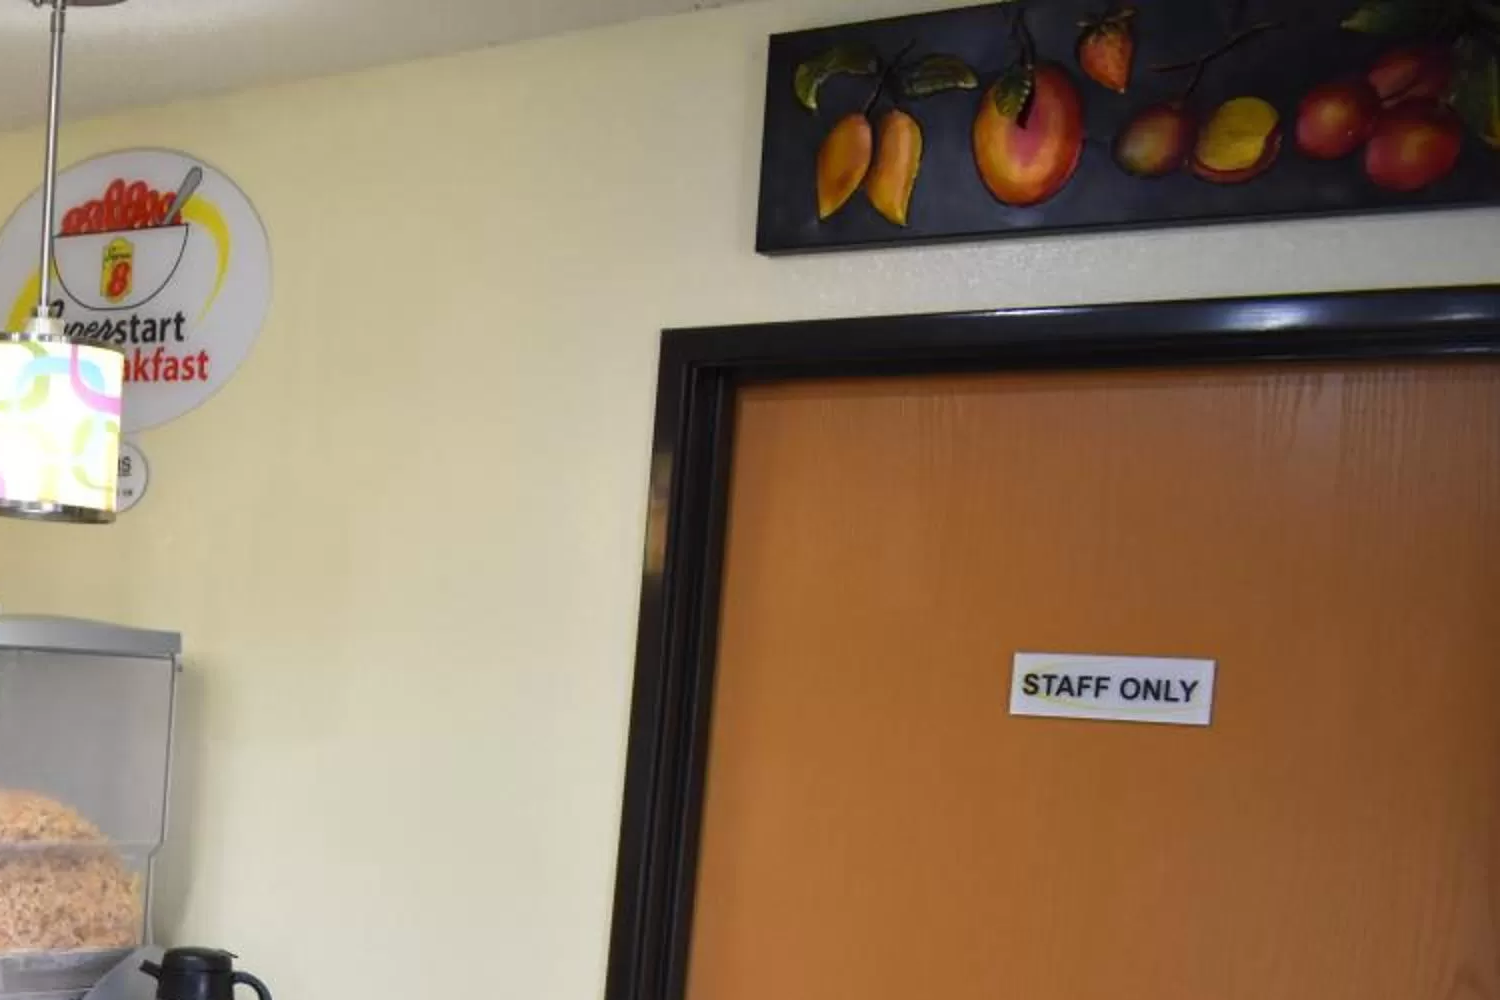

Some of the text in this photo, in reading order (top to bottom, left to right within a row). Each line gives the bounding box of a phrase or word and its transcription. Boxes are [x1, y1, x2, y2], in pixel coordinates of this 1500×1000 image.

[105, 260, 133, 301] 8
[124, 349, 210, 384] kfast
[1022, 673, 1199, 702] STAFF ONLY
